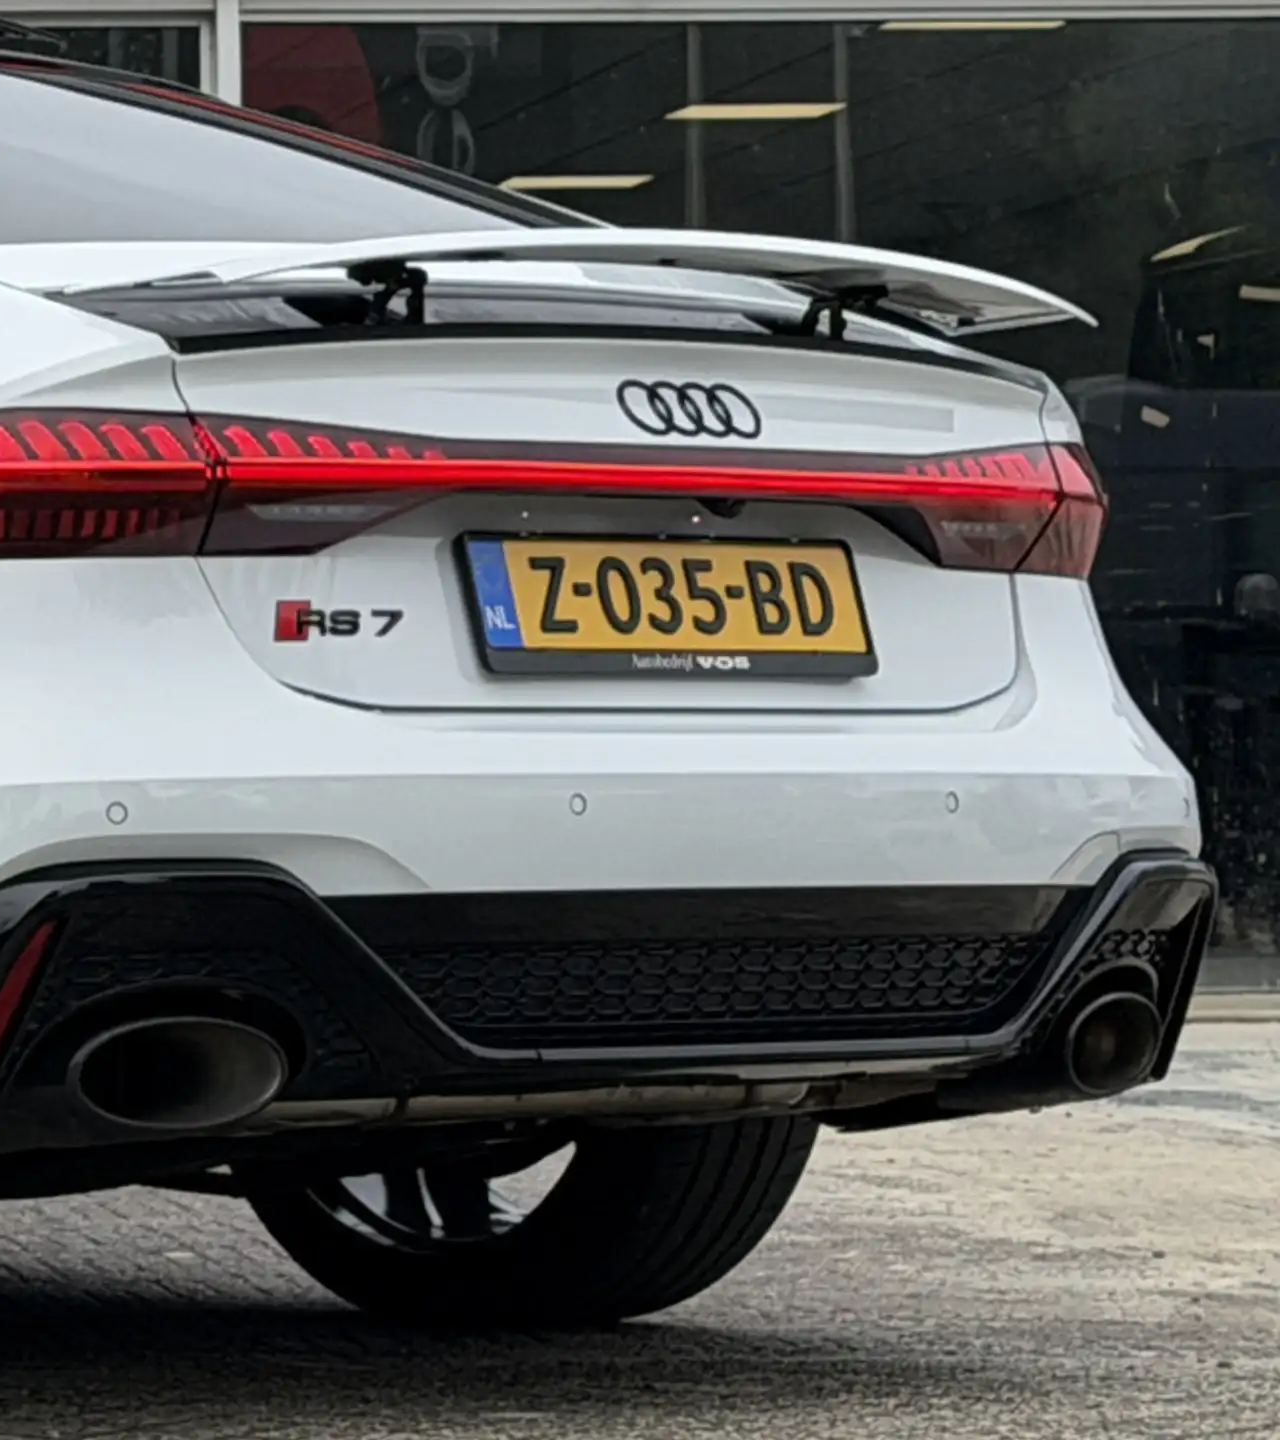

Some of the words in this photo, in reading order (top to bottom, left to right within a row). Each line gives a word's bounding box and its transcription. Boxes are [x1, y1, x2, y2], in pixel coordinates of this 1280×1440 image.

[529, 556, 834, 637] Z-035-BD
[485, 605, 516, 630] NL
[696, 655, 751, 670] VOS
